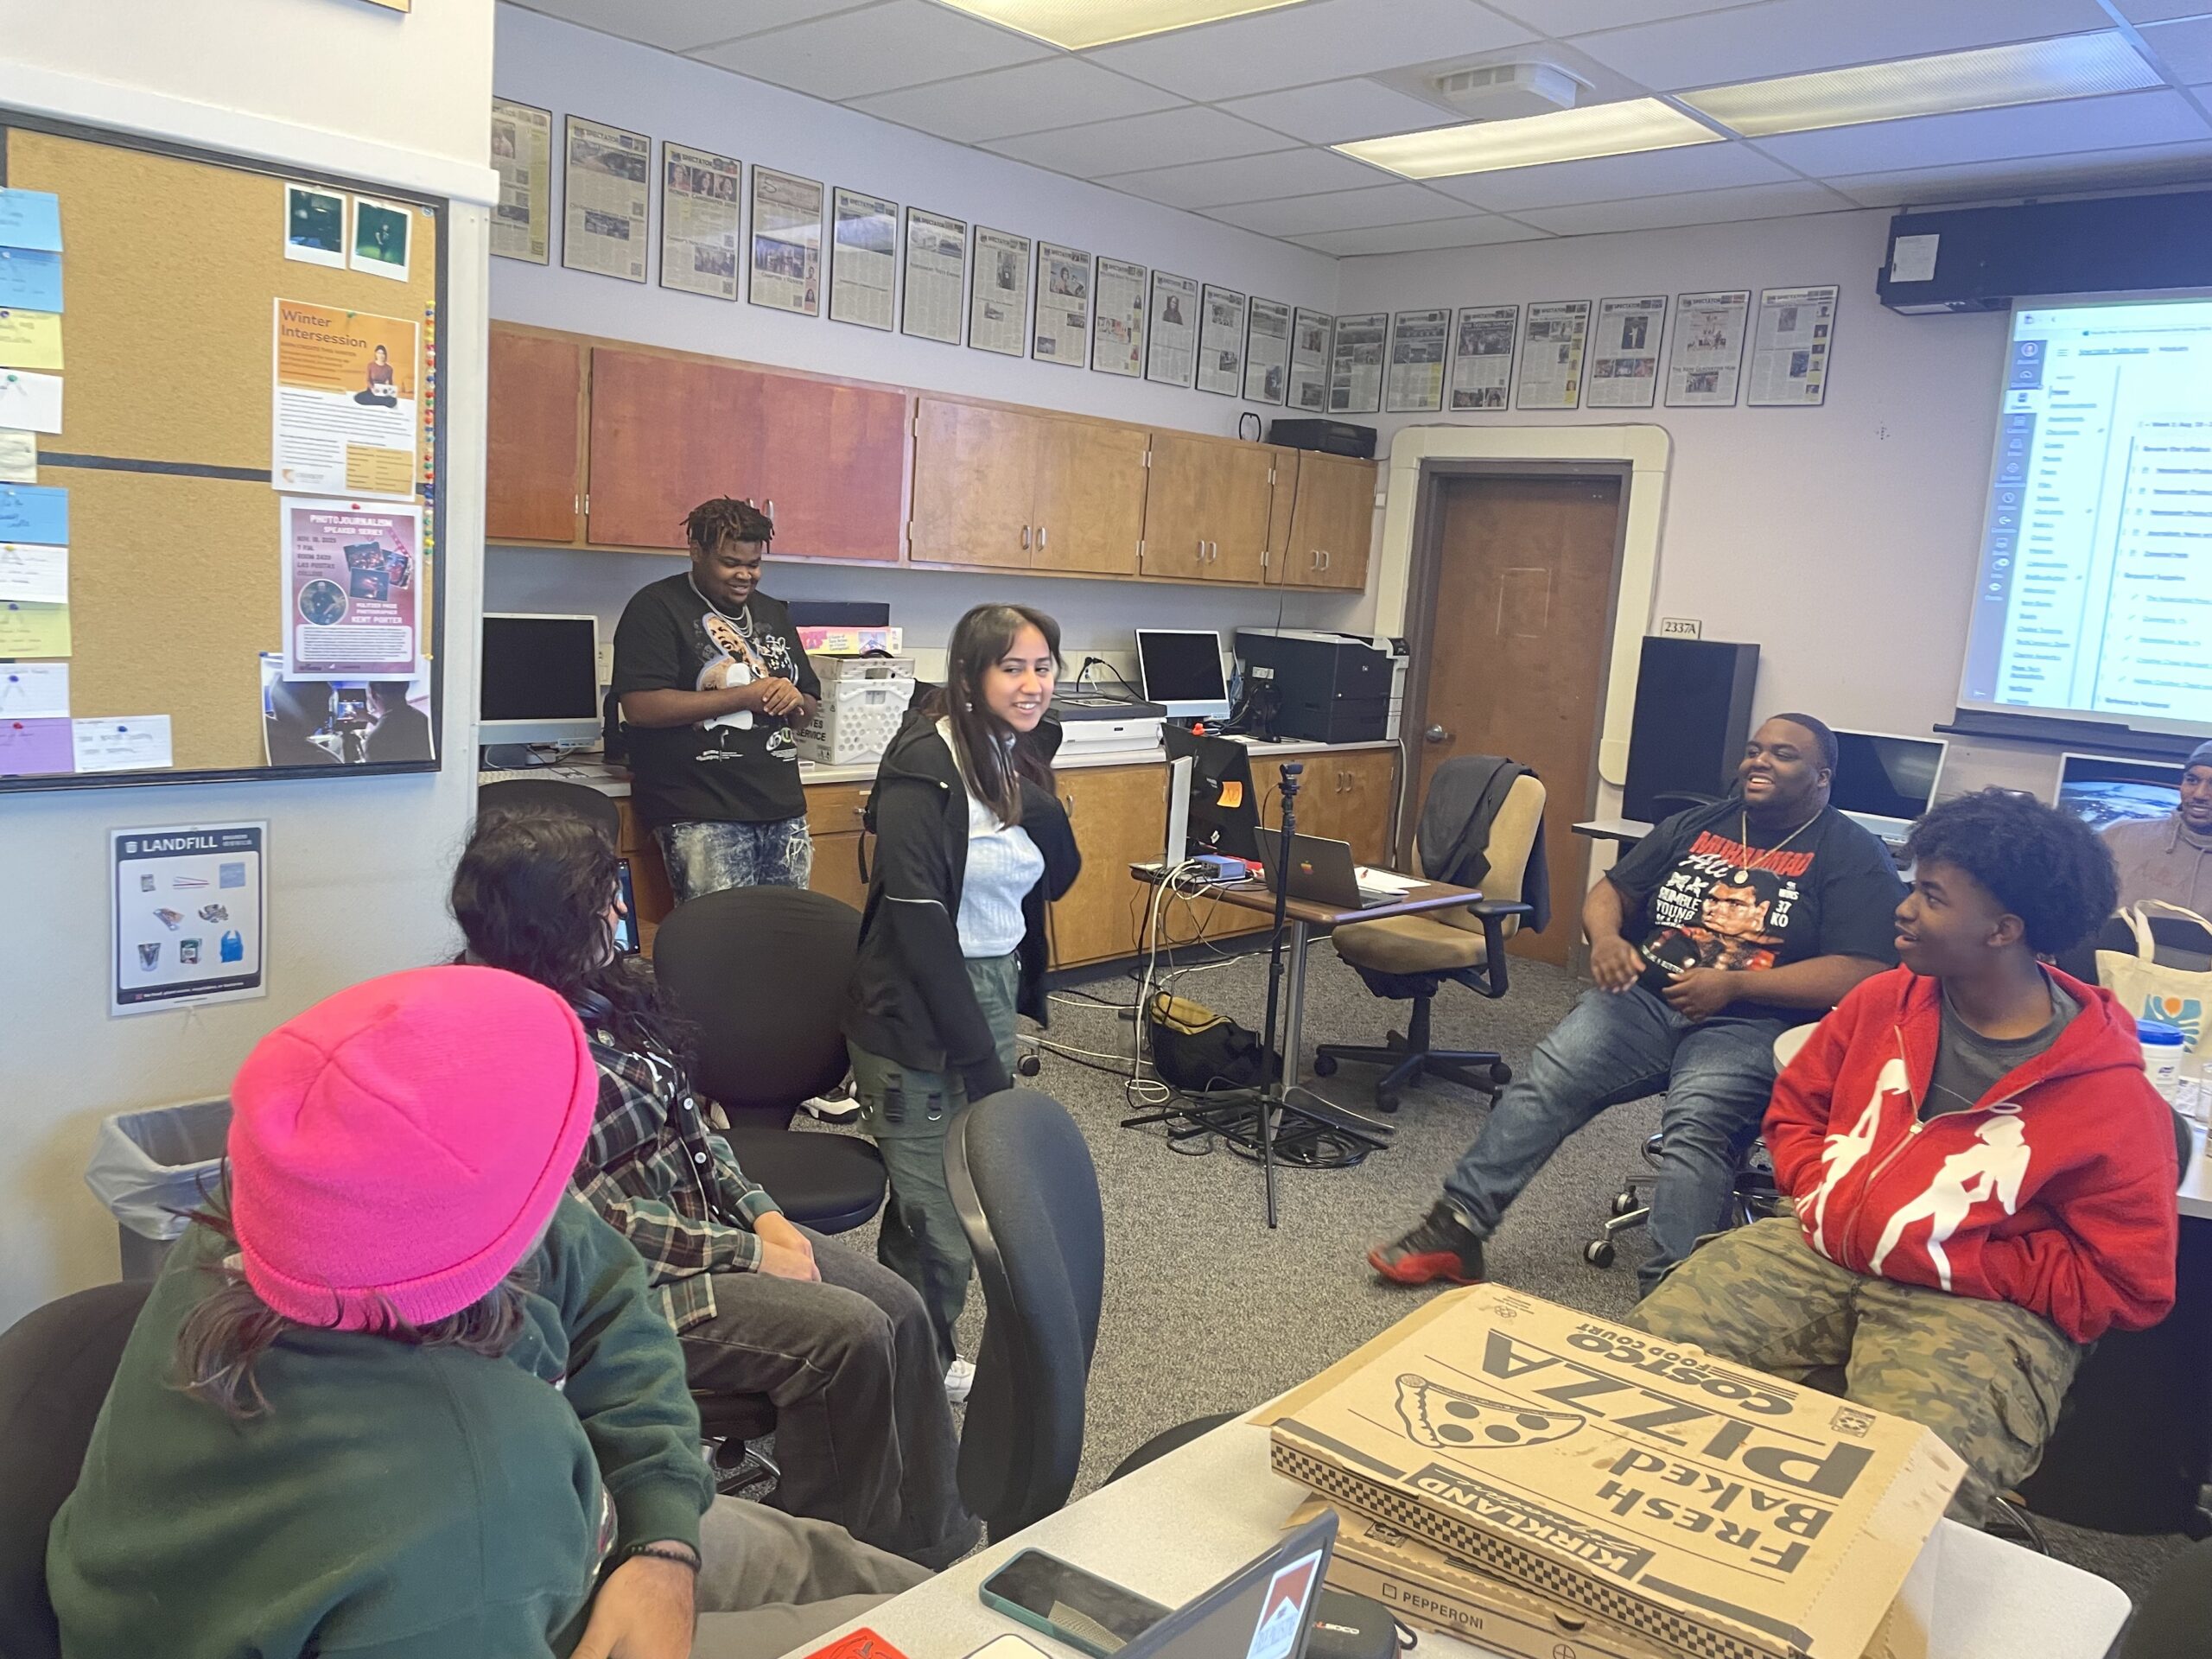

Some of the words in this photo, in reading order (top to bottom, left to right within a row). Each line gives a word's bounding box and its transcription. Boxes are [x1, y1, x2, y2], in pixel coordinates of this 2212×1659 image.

[682, 154, 712, 167] SPECTATOR
[282, 308, 332, 327] Winter
[282, 324, 367, 348] Intersession
[309, 514, 394, 527] PHOTOJOURNALISM
[323, 526, 356, 535] SPEAKER
[1664, 621, 1696, 634] 2337A
[143, 836, 219, 853] LANDFILL
[1689, 830, 1815, 877] MUHAMMAD
[1656, 899, 1695, 921] YOUNG
[1775, 899, 1792, 914] 37
[1770, 912, 1789, 928] KO
[1575, 1323, 1649, 1351] COURT
[1646, 1344, 1711, 1373] FOOD
[1566, 1333, 1794, 1416] COSTCO
[1482, 1330, 1875, 1500] PIZZA
[1416, 1477, 1630, 1573] KIRKLAND
[1402, 1590, 1484, 1630] PEPPERONI
